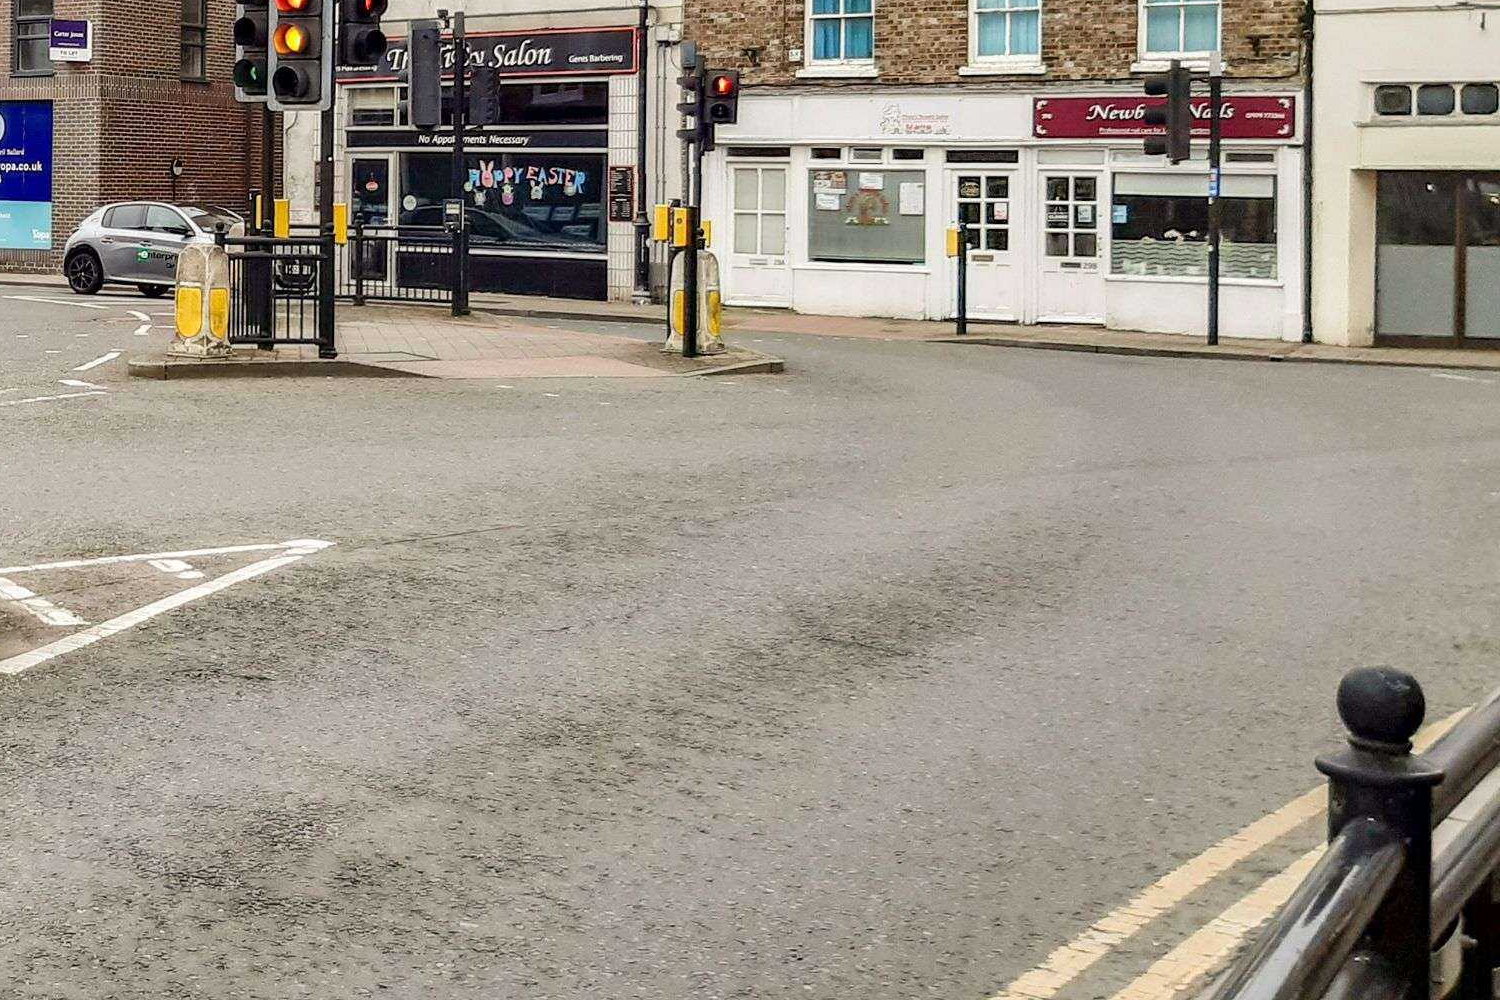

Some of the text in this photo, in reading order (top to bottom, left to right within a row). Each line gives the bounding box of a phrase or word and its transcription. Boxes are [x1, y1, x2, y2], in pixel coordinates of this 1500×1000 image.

[386, 48, 412, 70] Th
[488, 39, 553, 69] Salon
[568, 53, 624, 64] Gents Barbering
[1086, 103, 1146, 120] Newb
[1188, 102, 1236, 119] Nals
[418, 134, 529, 146] No Appoiments Necessary
[526, 166, 586, 194] EASTER
[140, 250, 180, 261] enterpri
